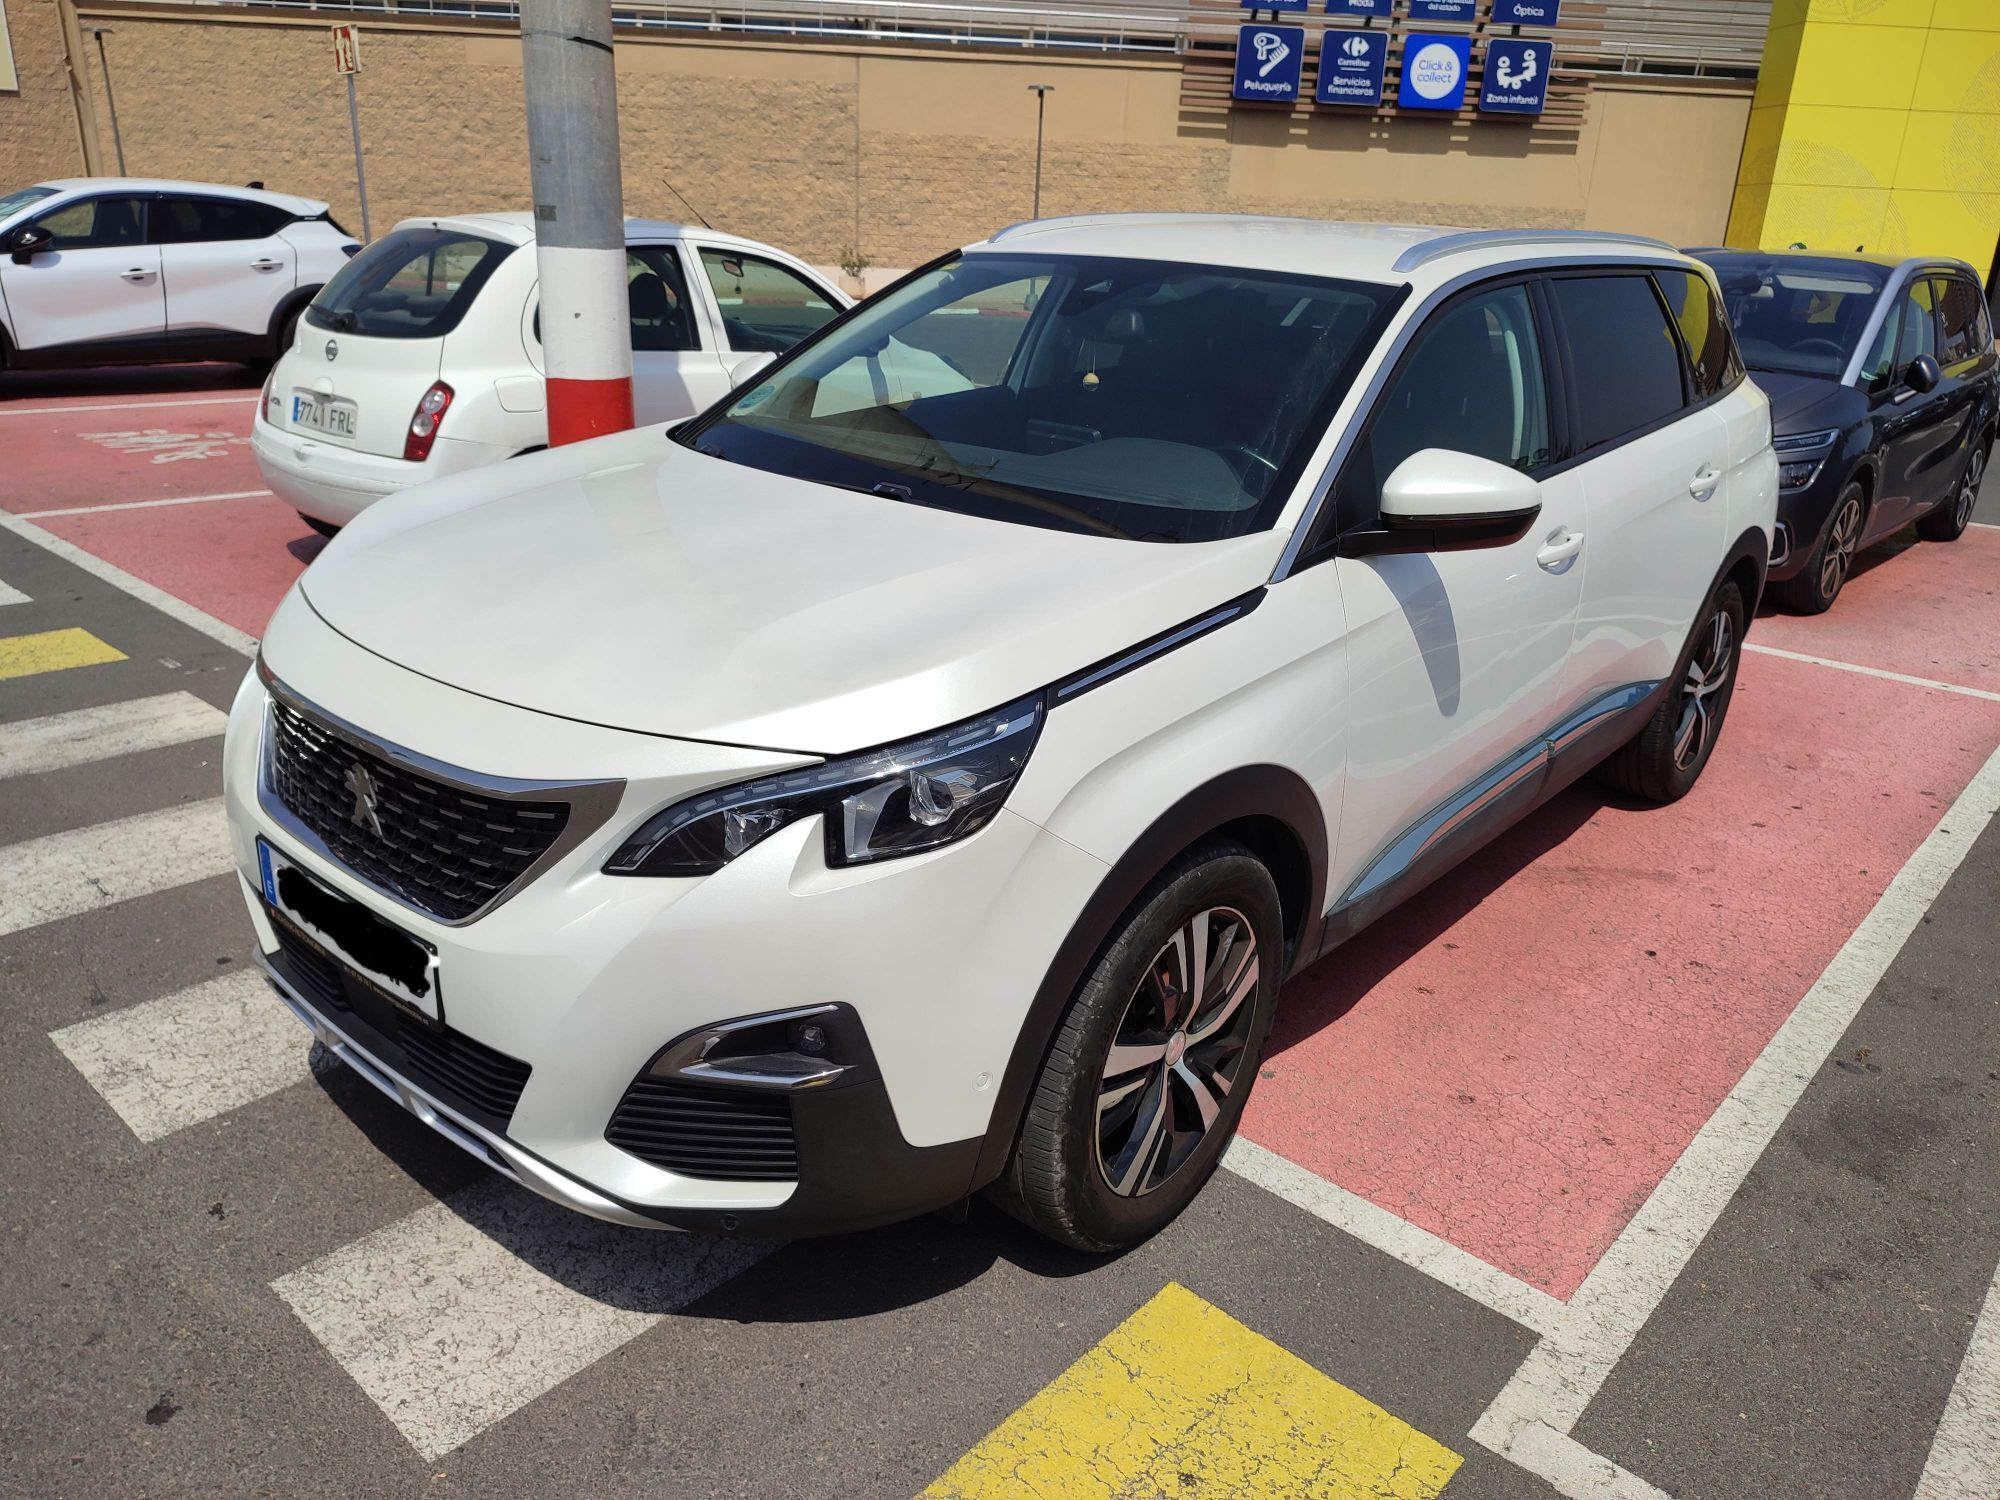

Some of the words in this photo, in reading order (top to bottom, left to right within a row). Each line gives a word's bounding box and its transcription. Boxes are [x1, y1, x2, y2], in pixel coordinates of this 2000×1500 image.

[1348, 0, 1375, 8] Moda
[1428, 3, 1438, 11] del
[1439, 4, 1461, 12] estado
[1513, 3, 1544, 18] Óptica
[1418, 59, 1443, 71] Click
[1445, 61, 1452, 71] &
[1333, 76, 1371, 87] Servicios
[1417, 72, 1451, 84] collect
[1244, 80, 1291, 93] Peluquería
[1328, 84, 1375, 96] financieros
[1487, 93, 1508, 103] Zona
[1509, 94, 1538, 104] infantil
[299, 402, 325, 427] 7741
[330, 410, 353, 434] FRL
